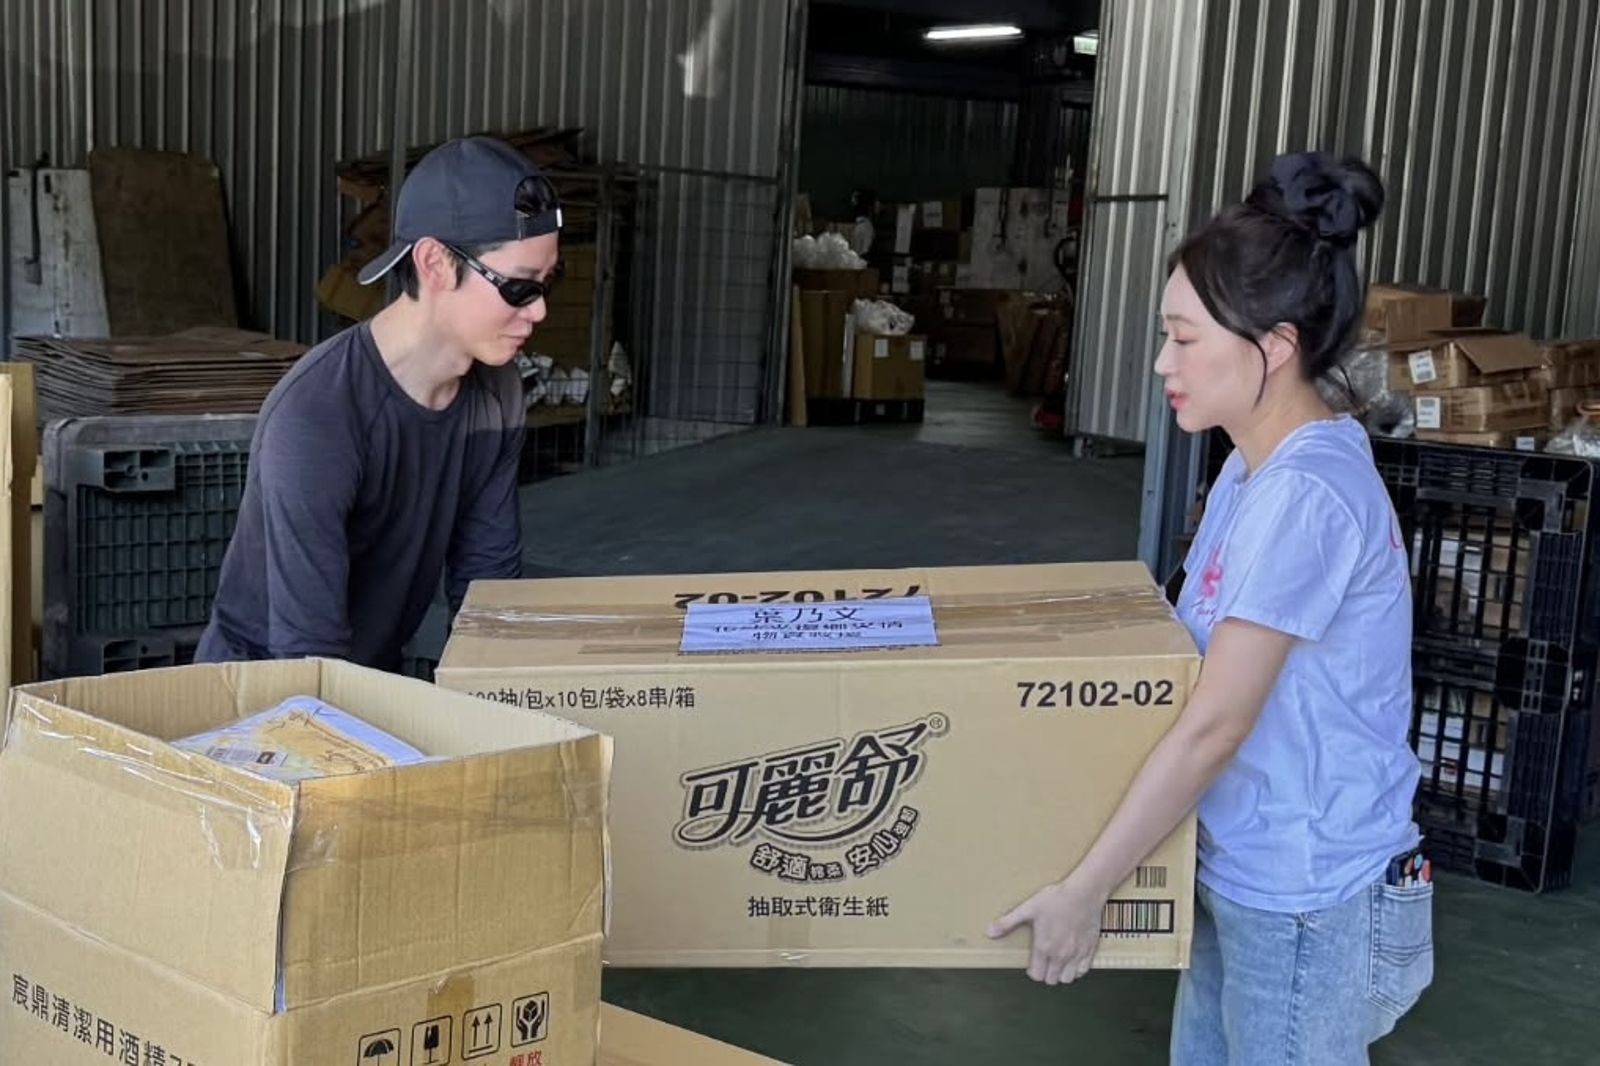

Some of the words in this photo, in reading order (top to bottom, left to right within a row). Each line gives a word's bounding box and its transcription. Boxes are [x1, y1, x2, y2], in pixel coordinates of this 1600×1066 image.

[1017, 680, 1174, 707] 72102-02
[676, 721, 929, 845] 可麗舒
[747, 896, 889, 918] 抽取式衛生紙
[12, 974, 197, 1066] 宸鼎清潔用酒精
